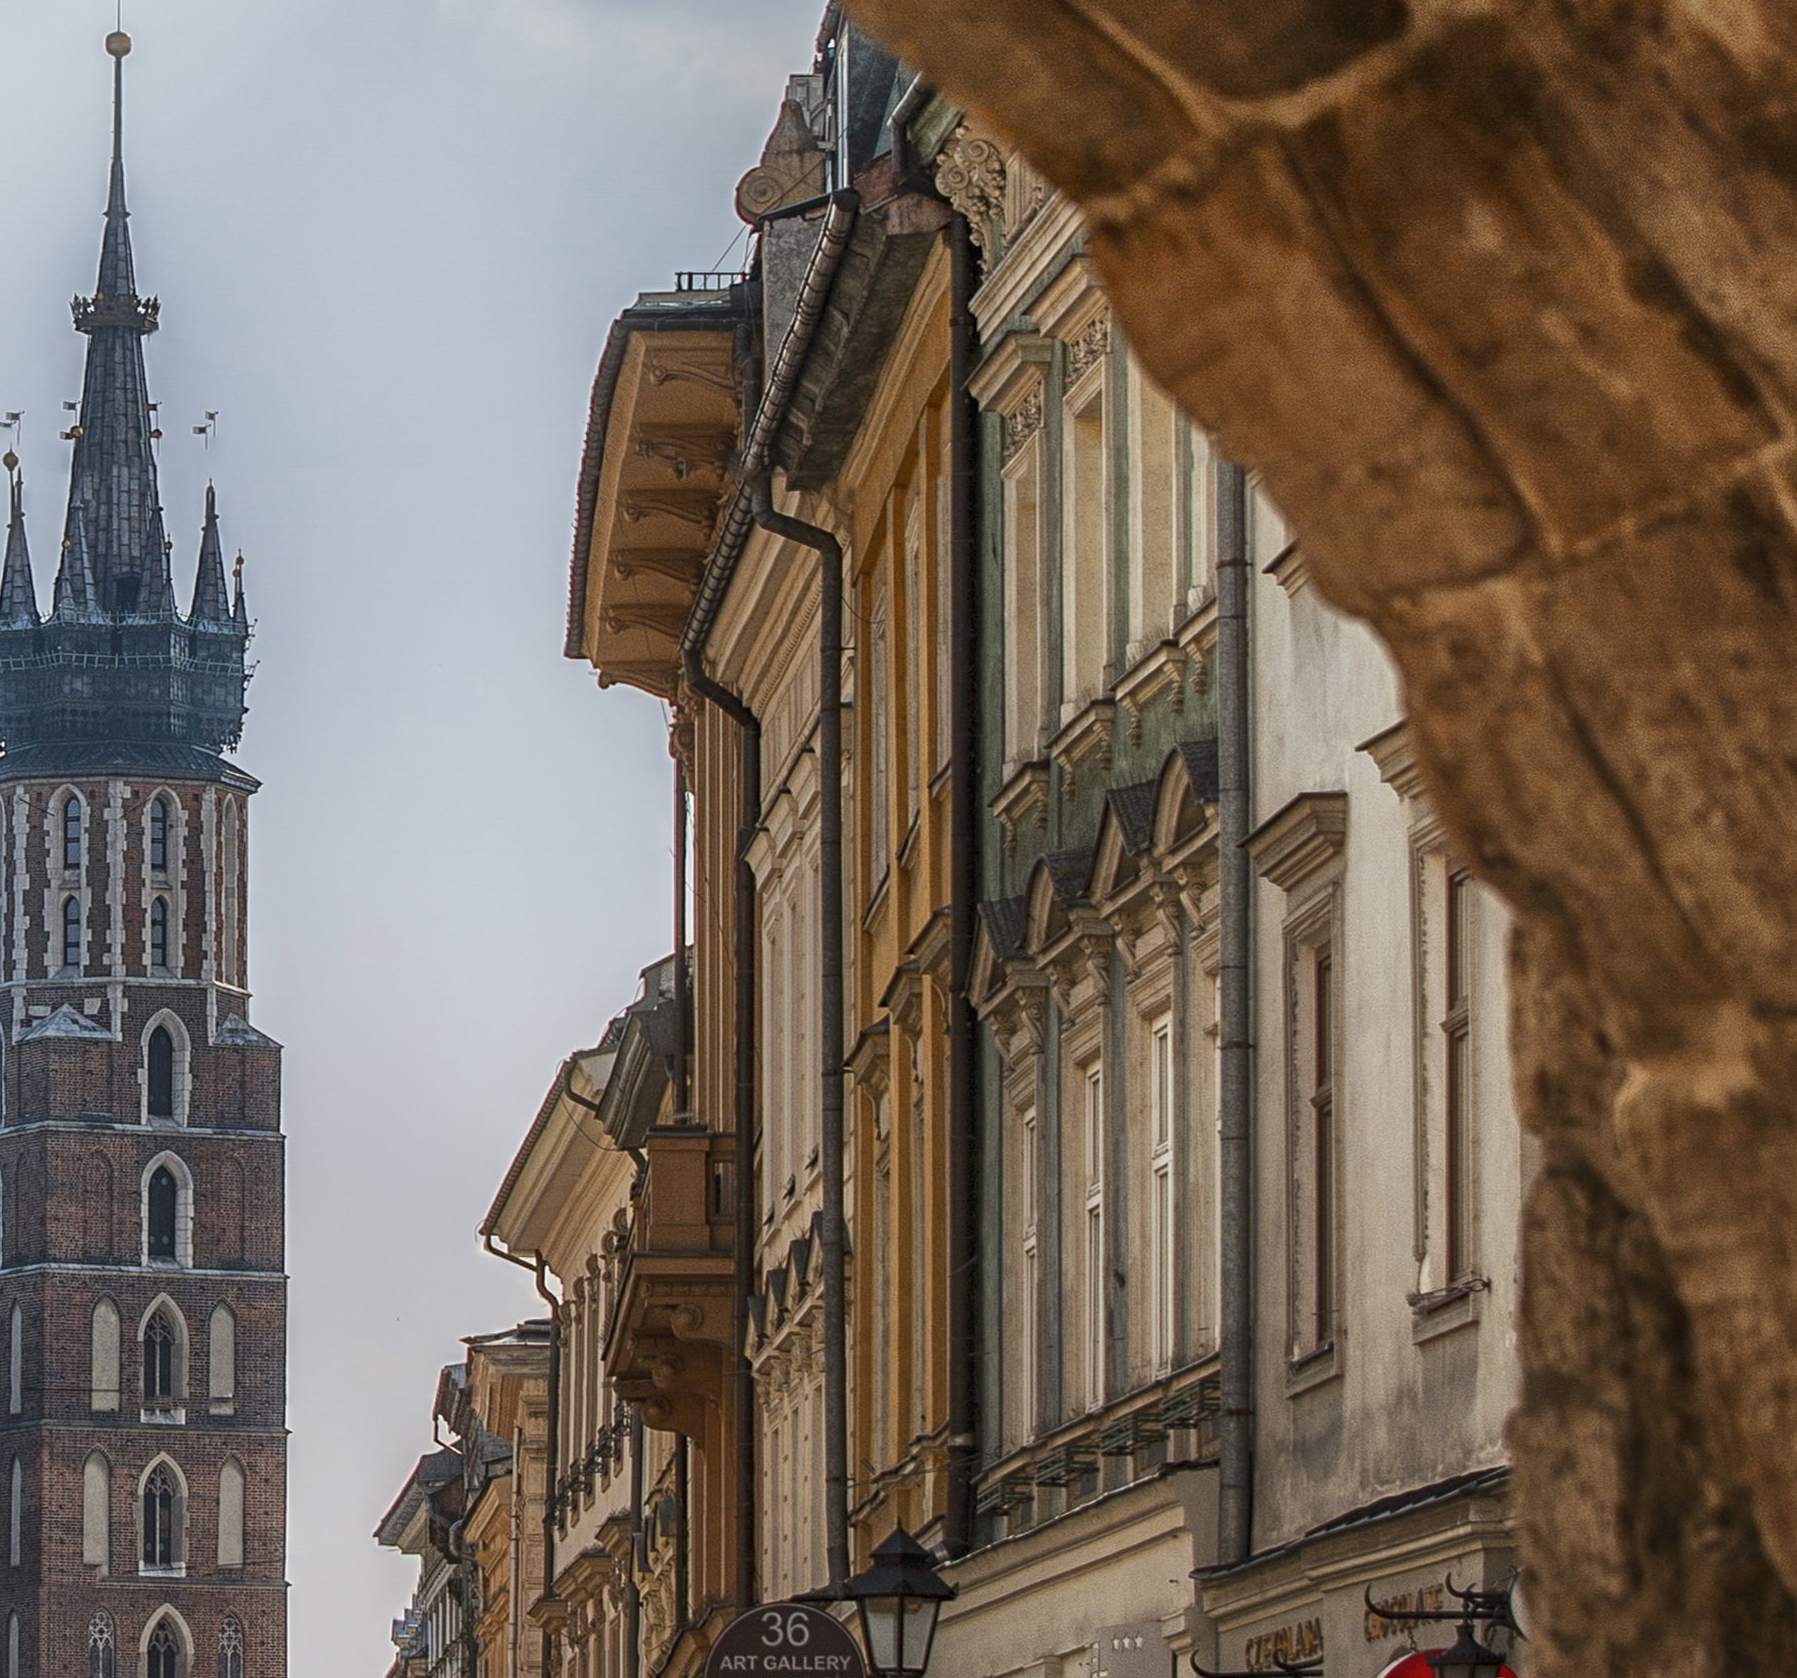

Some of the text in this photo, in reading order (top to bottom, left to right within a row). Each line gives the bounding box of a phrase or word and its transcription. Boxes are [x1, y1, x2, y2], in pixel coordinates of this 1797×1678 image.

[760, 1611, 810, 1647] 36
[719, 1655, 852, 1671] ART GALLERY
